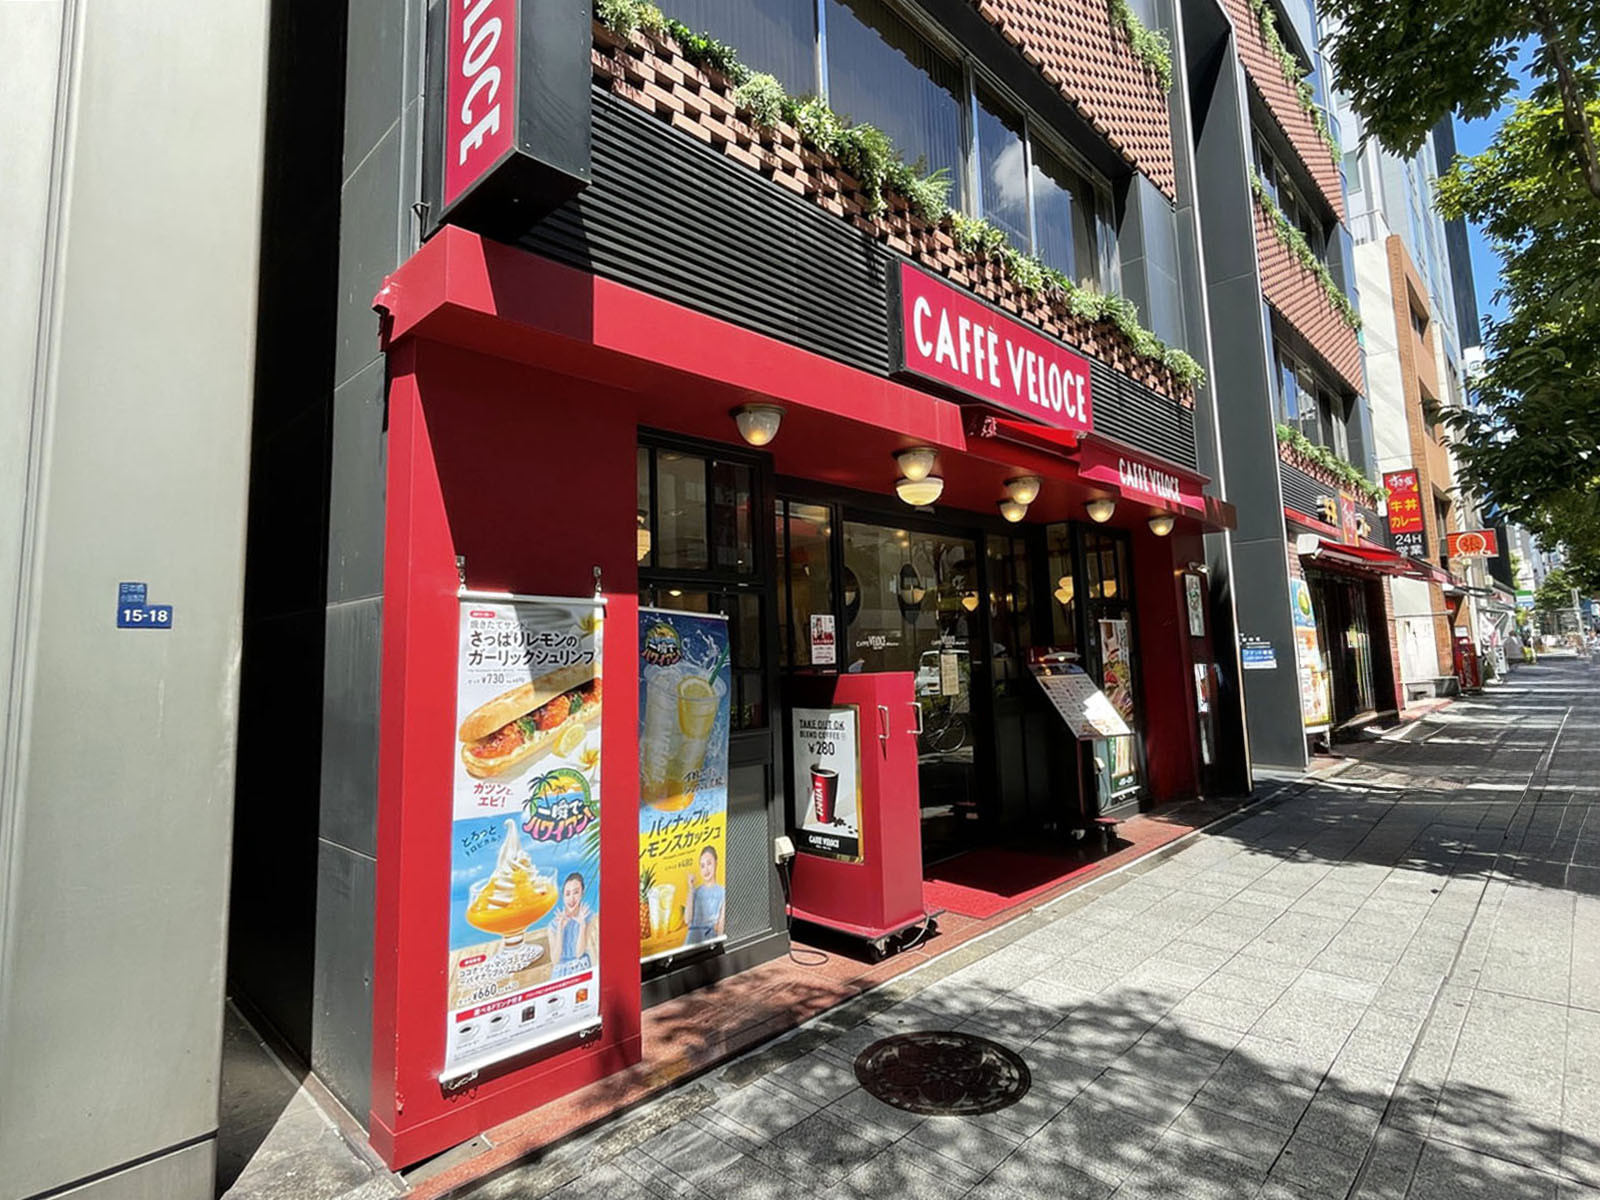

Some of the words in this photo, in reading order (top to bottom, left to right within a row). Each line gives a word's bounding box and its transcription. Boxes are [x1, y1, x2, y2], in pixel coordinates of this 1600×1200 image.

[913, 296, 1001, 388] CAFFÈ
[1006, 339, 1087, 424] VELOCE
[1148, 468, 1181, 503] VELOCE
[1391, 516, 1421, 528] カレー
[1394, 534, 1422, 545] 24H
[123, 609, 169, 622] 15-18
[470, 631, 578, 648] さっぱりレモンの
[799, 719, 816, 730] TAKE
[817, 719, 832, 731] OUT
[833, 719, 845, 731] OK
[799, 730, 817, 739] BLEND
[818, 731, 840, 740] COFFEE
[808, 741, 835, 756] ¥280
[649, 808, 710, 839] パイナップル
[461, 825, 497, 848] とろっと
[472, 984, 497, 1000] ¥660
